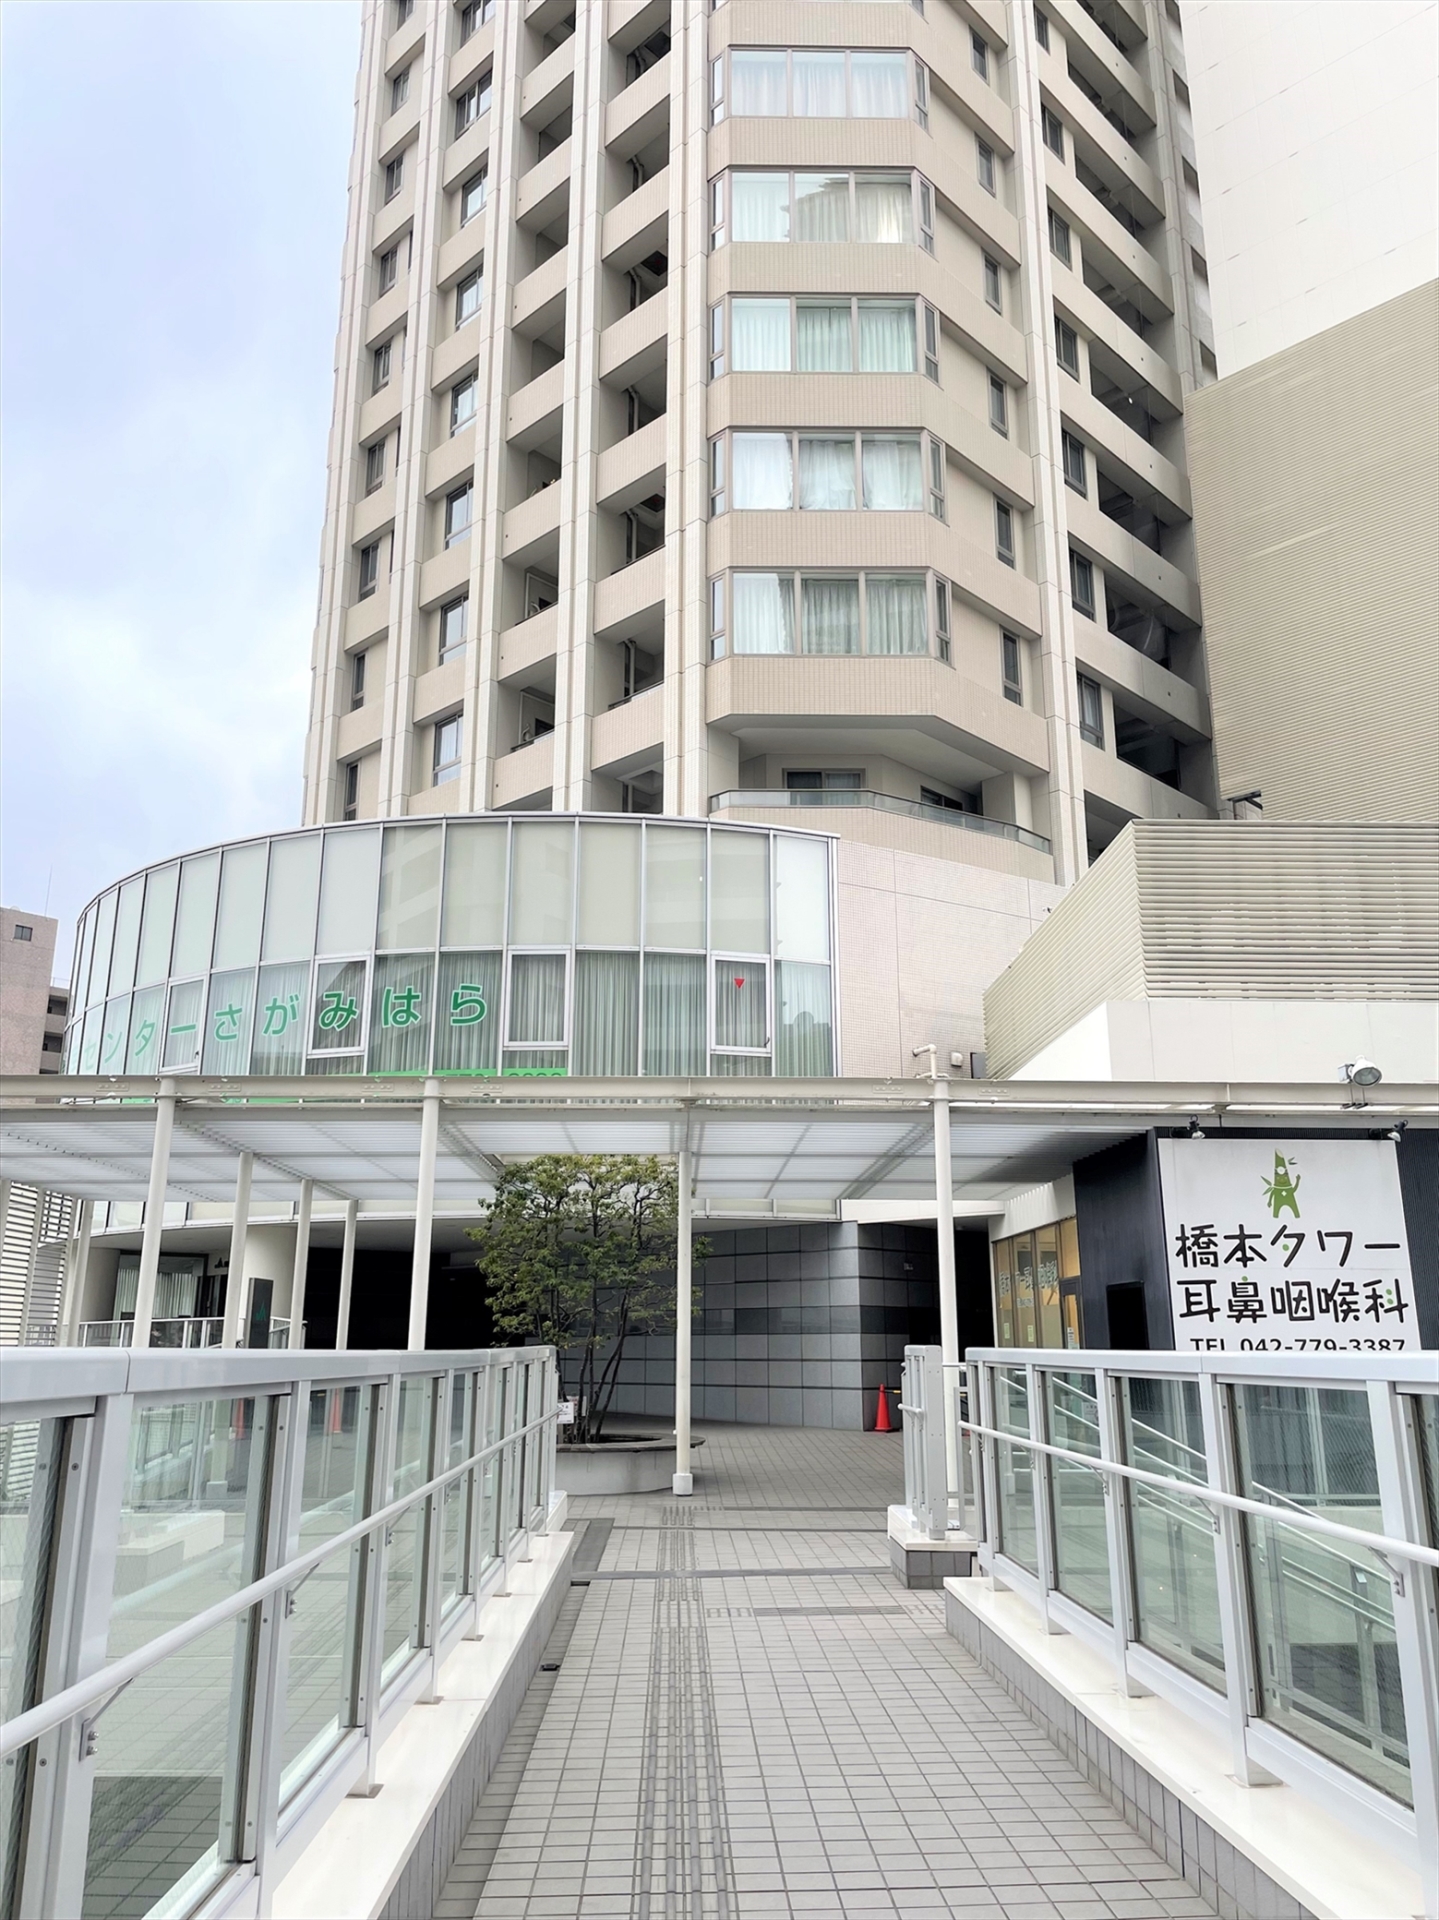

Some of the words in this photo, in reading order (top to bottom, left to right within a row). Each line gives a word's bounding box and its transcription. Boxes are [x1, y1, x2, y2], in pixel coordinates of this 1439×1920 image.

[1175, 1223, 1401, 1269] 橋本タワー
[1176, 1276, 1409, 1324] 耳鼻咽喉科
